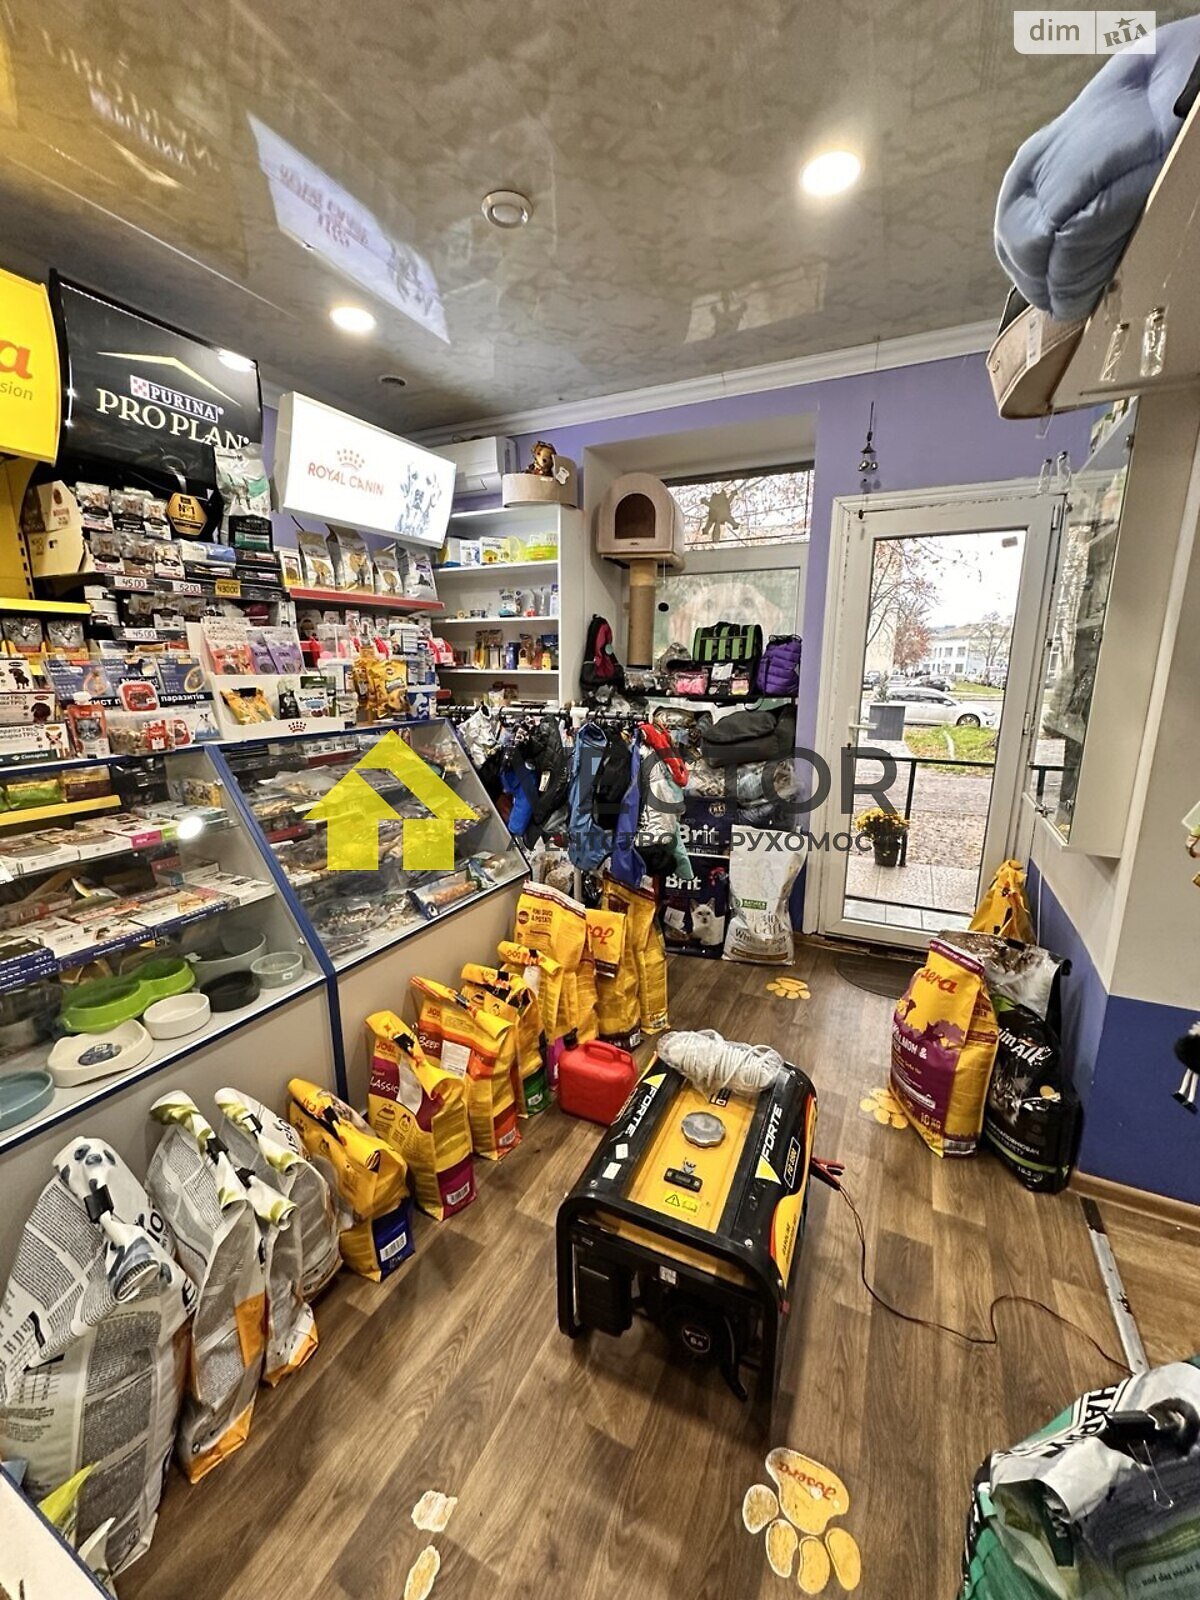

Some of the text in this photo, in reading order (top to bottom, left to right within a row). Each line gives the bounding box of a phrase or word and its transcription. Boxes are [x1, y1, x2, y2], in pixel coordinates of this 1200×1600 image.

[96, 388, 246, 450] PRO PLAN
[149, 386, 217, 420] PURINA
[308, 462, 384, 496] ROYAL CANIN
[625, 1085, 658, 1138] FORTE
[761, 1103, 783, 1163] FORTE
